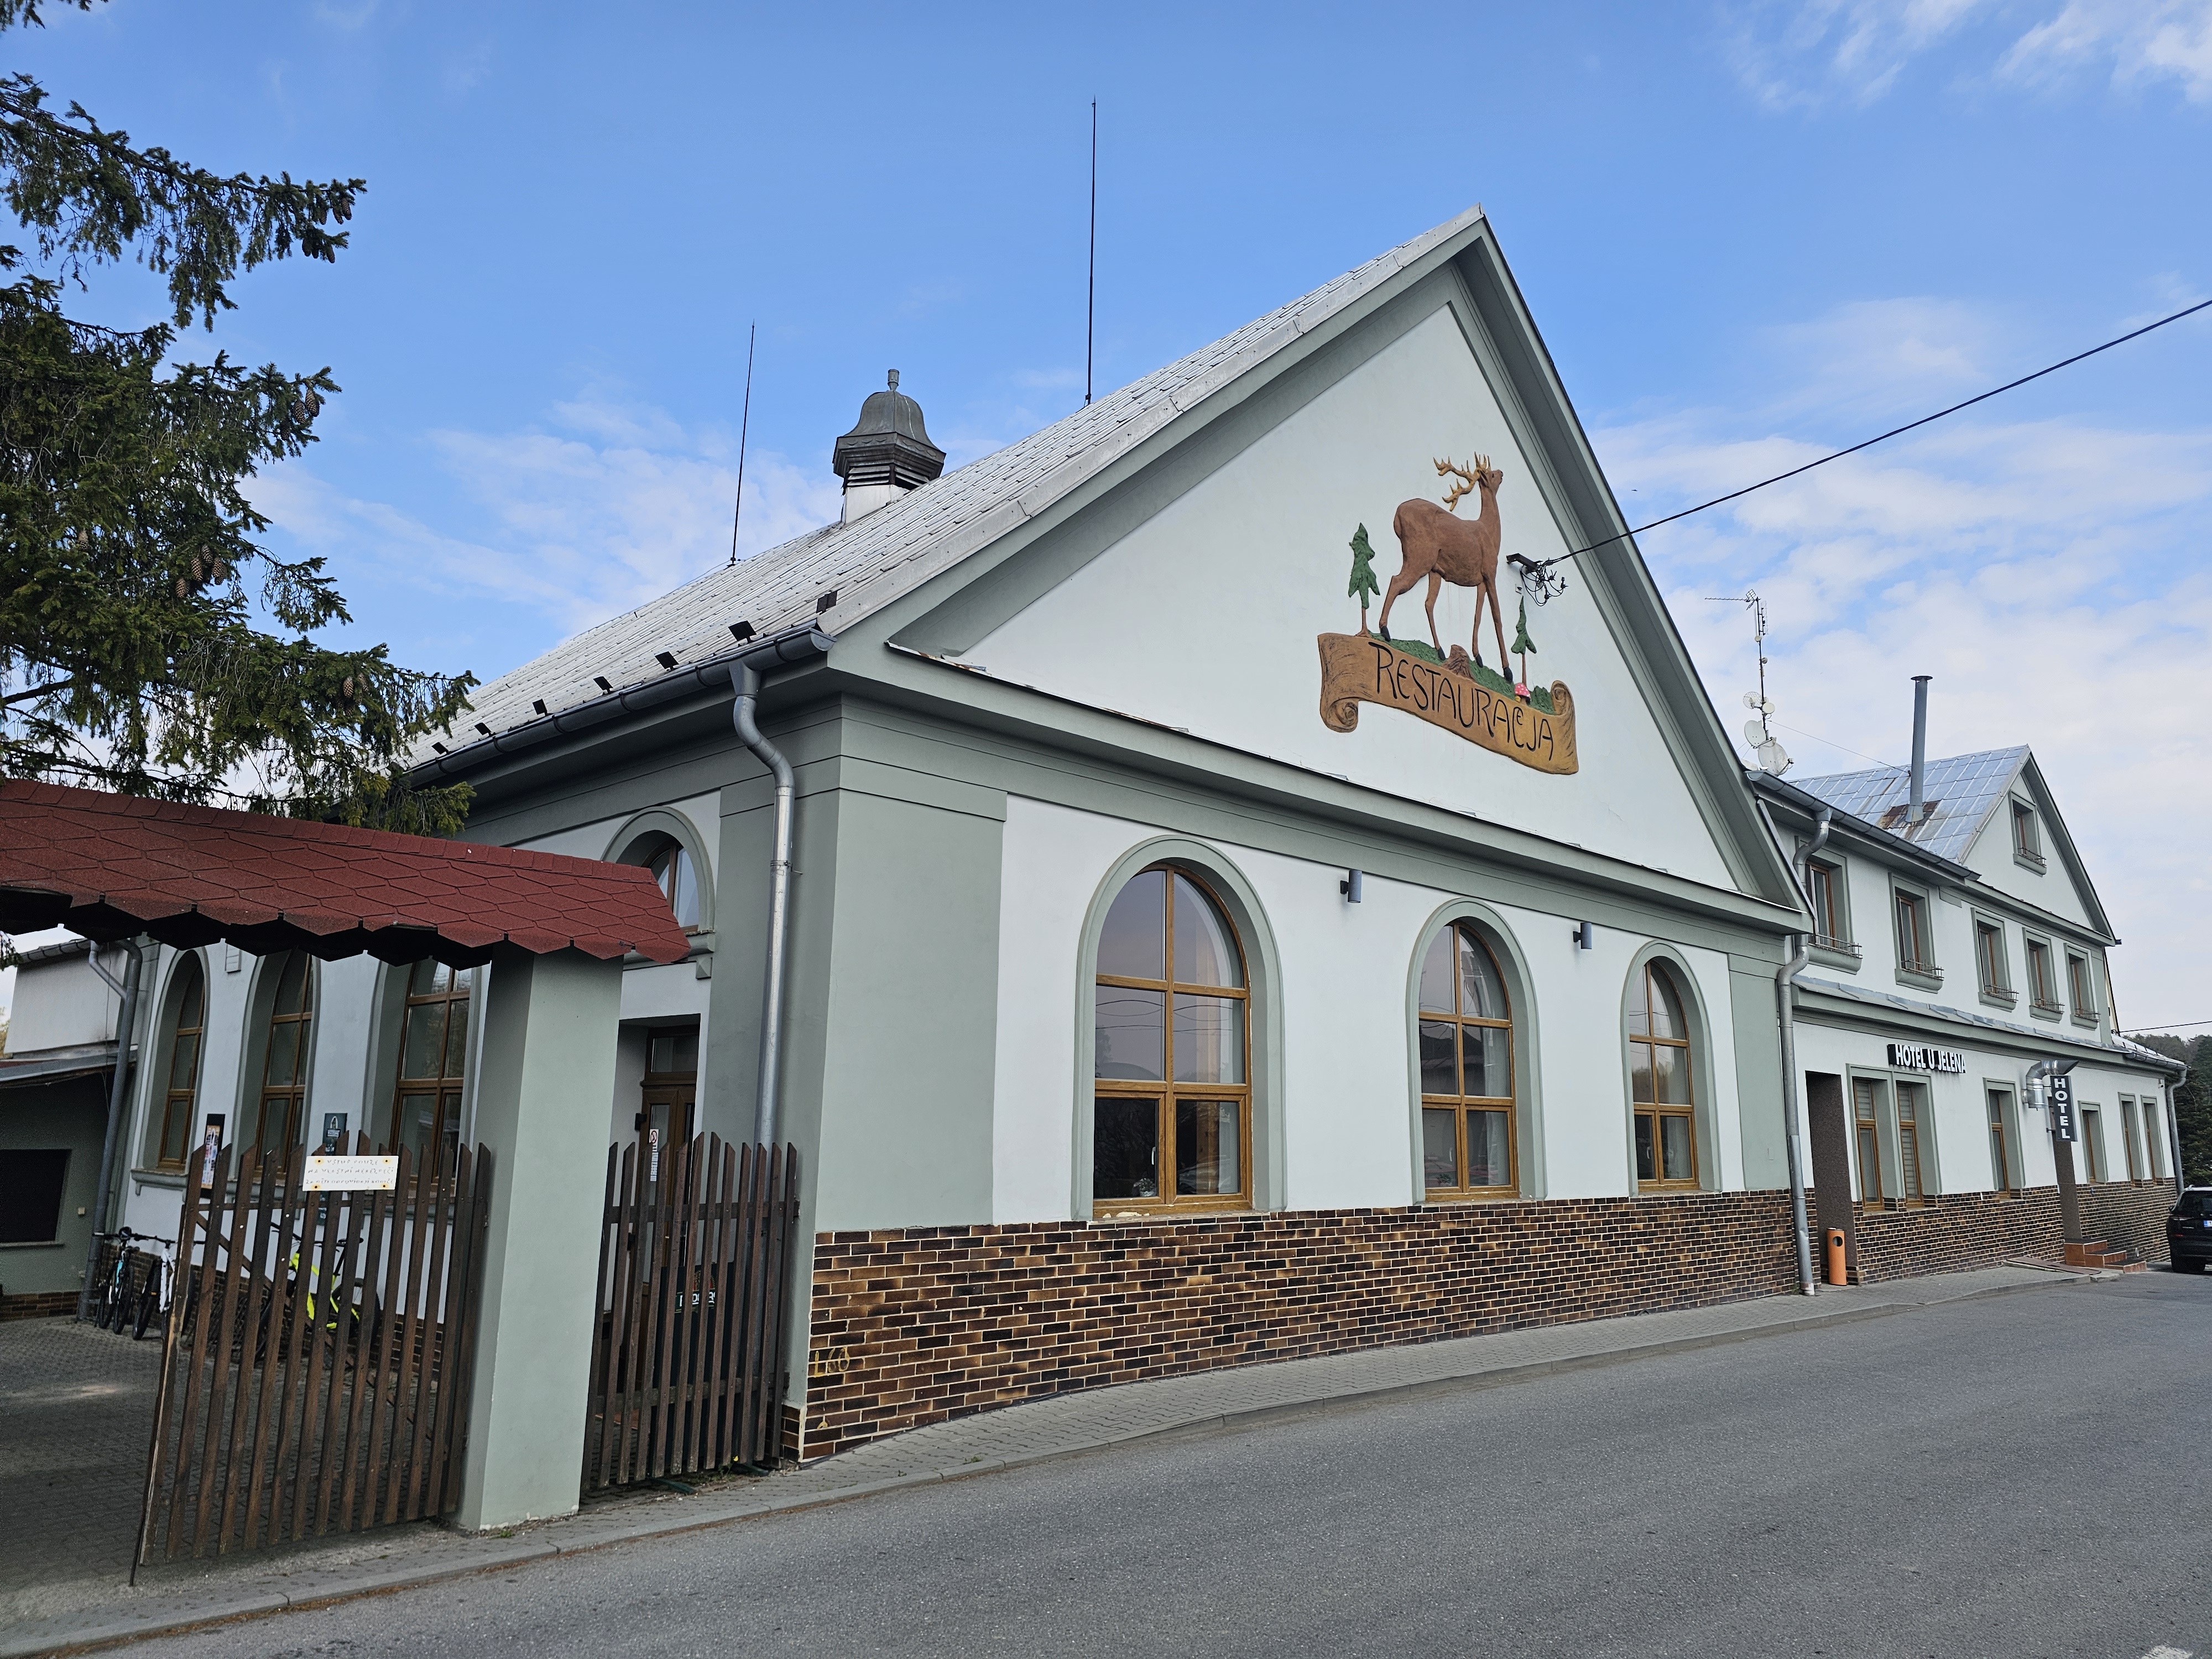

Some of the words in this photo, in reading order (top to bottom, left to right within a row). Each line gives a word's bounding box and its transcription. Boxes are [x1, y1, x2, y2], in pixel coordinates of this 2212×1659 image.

[1895, 1044, 1927, 1068] HOTEL
[1927, 1048, 1935, 1070] U
[1938, 1050, 1966, 1073] JELENA
[2054, 1078, 2070, 1139] HOTEL
